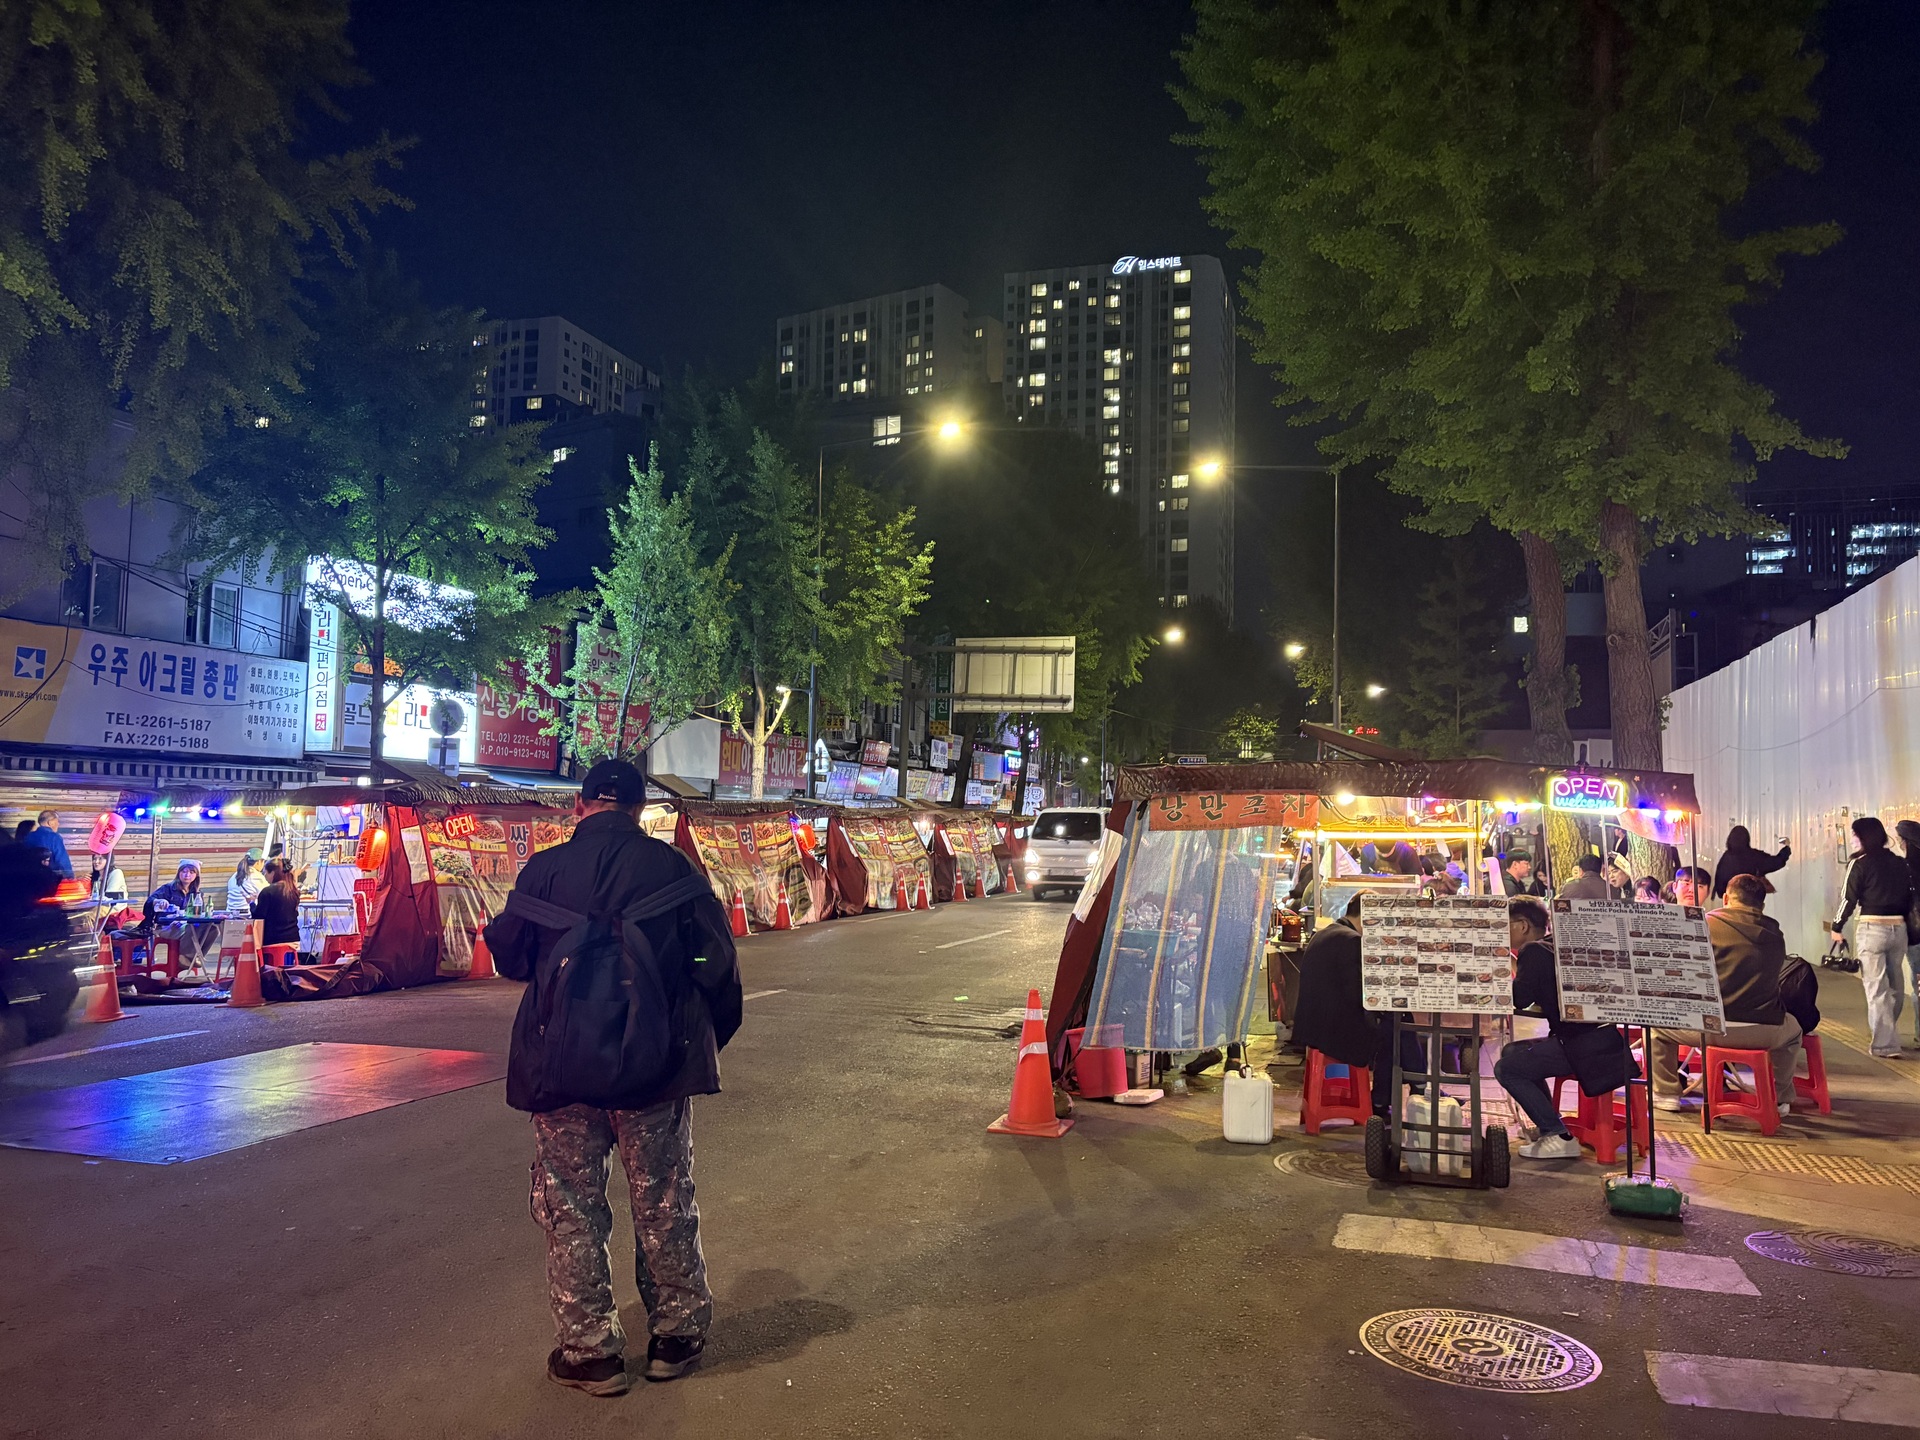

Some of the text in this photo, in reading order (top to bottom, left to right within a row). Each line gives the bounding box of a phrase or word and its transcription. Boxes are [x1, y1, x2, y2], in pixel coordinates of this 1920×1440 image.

[1138, 256, 1182, 271] 힐스테이트
[315, 611, 331, 708] 라면편의점
[88, 643, 239, 701] 우주 아크릴 총판
[105, 711, 212, 731] TEL:2261-5187
[104, 731, 209, 749] FAX:2261-5188
[513, 734, 550, 747] 2275-4794
[1555, 778, 1619, 799] OPEN
[1555, 792, 1617, 809] welcome
[445, 815, 475, 837] OPEN
